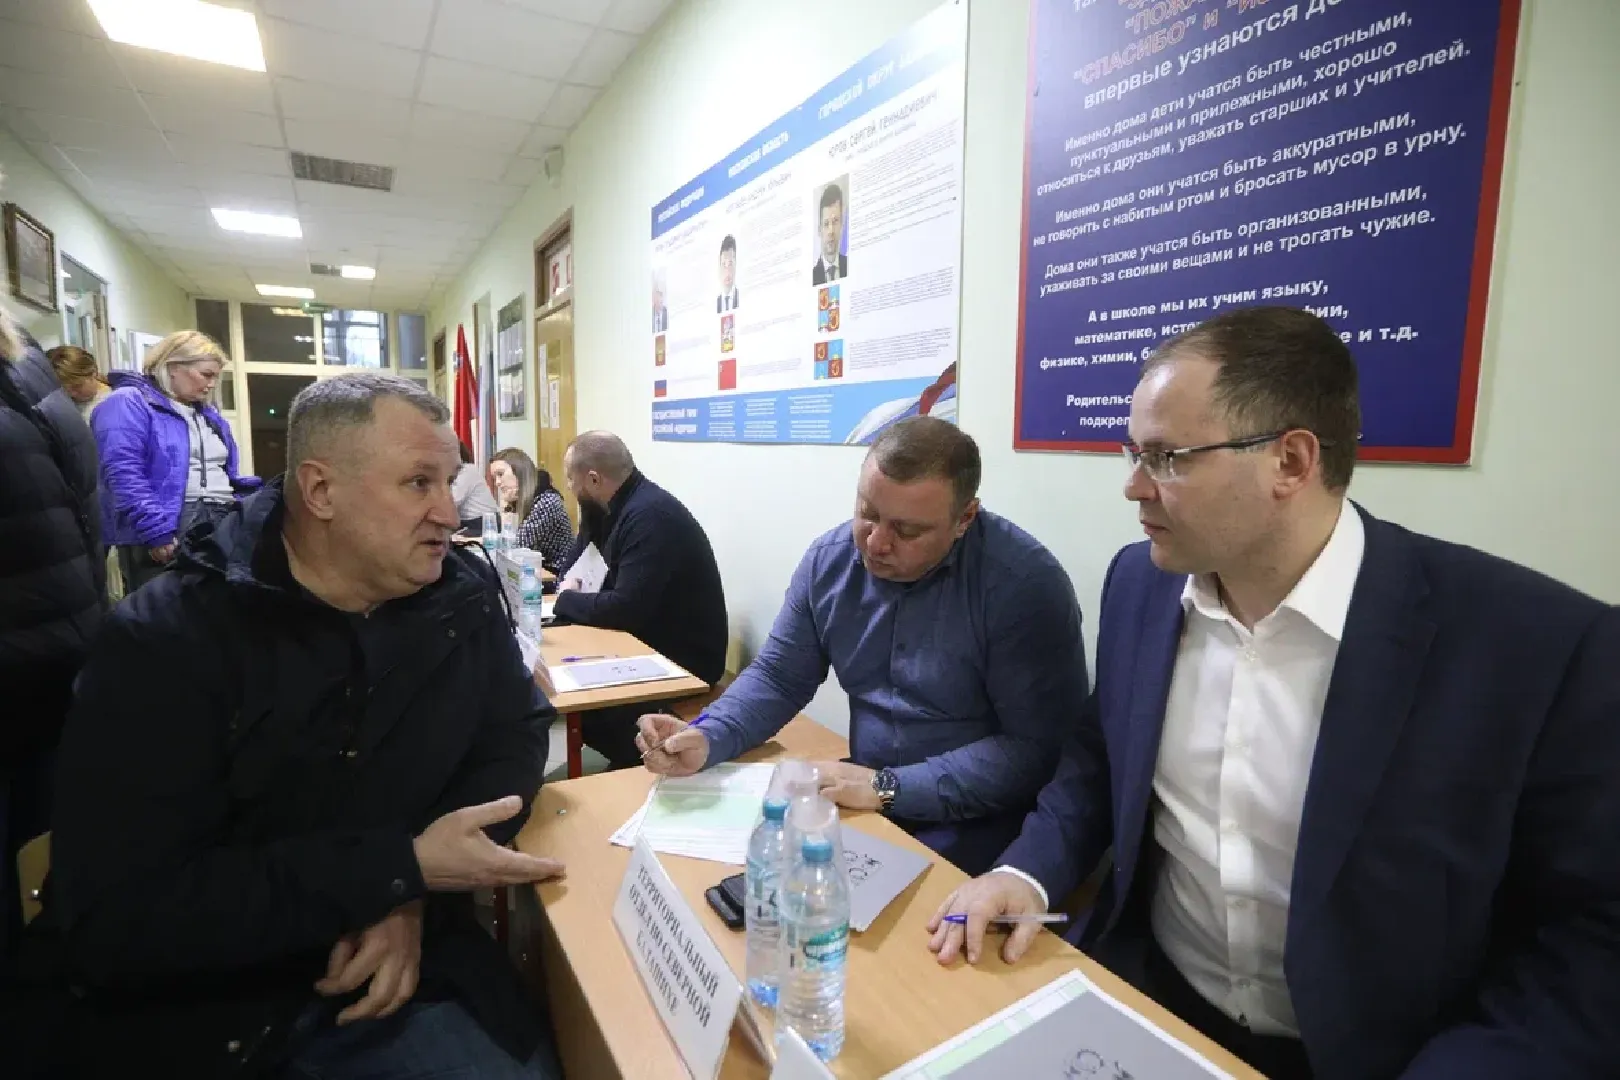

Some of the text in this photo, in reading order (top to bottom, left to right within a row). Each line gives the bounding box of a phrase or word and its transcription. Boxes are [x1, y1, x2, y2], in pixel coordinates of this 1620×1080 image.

[1065, 11, 1412, 152] Именно дома дети учатся быть честными,
[1070, 41, 1397, 168] пунктуальными и прилежными, хорошо
[1084, 59, 1173, 109] впервые
[1178, 4, 1298, 76] узнаются
[1036, 38, 1471, 196] относиться к друзьям, уважать старших и учителей.
[1033, 122, 1467, 247] не говорить с набитым ртом и бросать мусор в урну.
[1055, 111, 1416, 223] Именно дома они учатся быть аккуратными,
[1039, 209, 1436, 298] ухаживать за своими вещами и не трогать чужие.
[1044, 184, 1427, 280] Дома они также учатся быть организованными,
[1039, 354, 1088, 370] физике,
[1091, 351, 1138, 365] химии,
[1358, 329, 1372, 343] и
[1379, 325, 1419, 343] т.д.
[1074, 327, 1157, 346] математике,
[1161, 321, 1203, 336] исто
[1088, 279, 1329, 323] А в школе мы их учим языку,
[1066, 394, 1132, 407] Родительс
[1079, 416, 1130, 429] подкреп
[637, 863, 719, 998] ТЕРРИТОРИАЛЬНЫЙ
[661, 941, 711, 1027] СЕВЕРНОЙ
